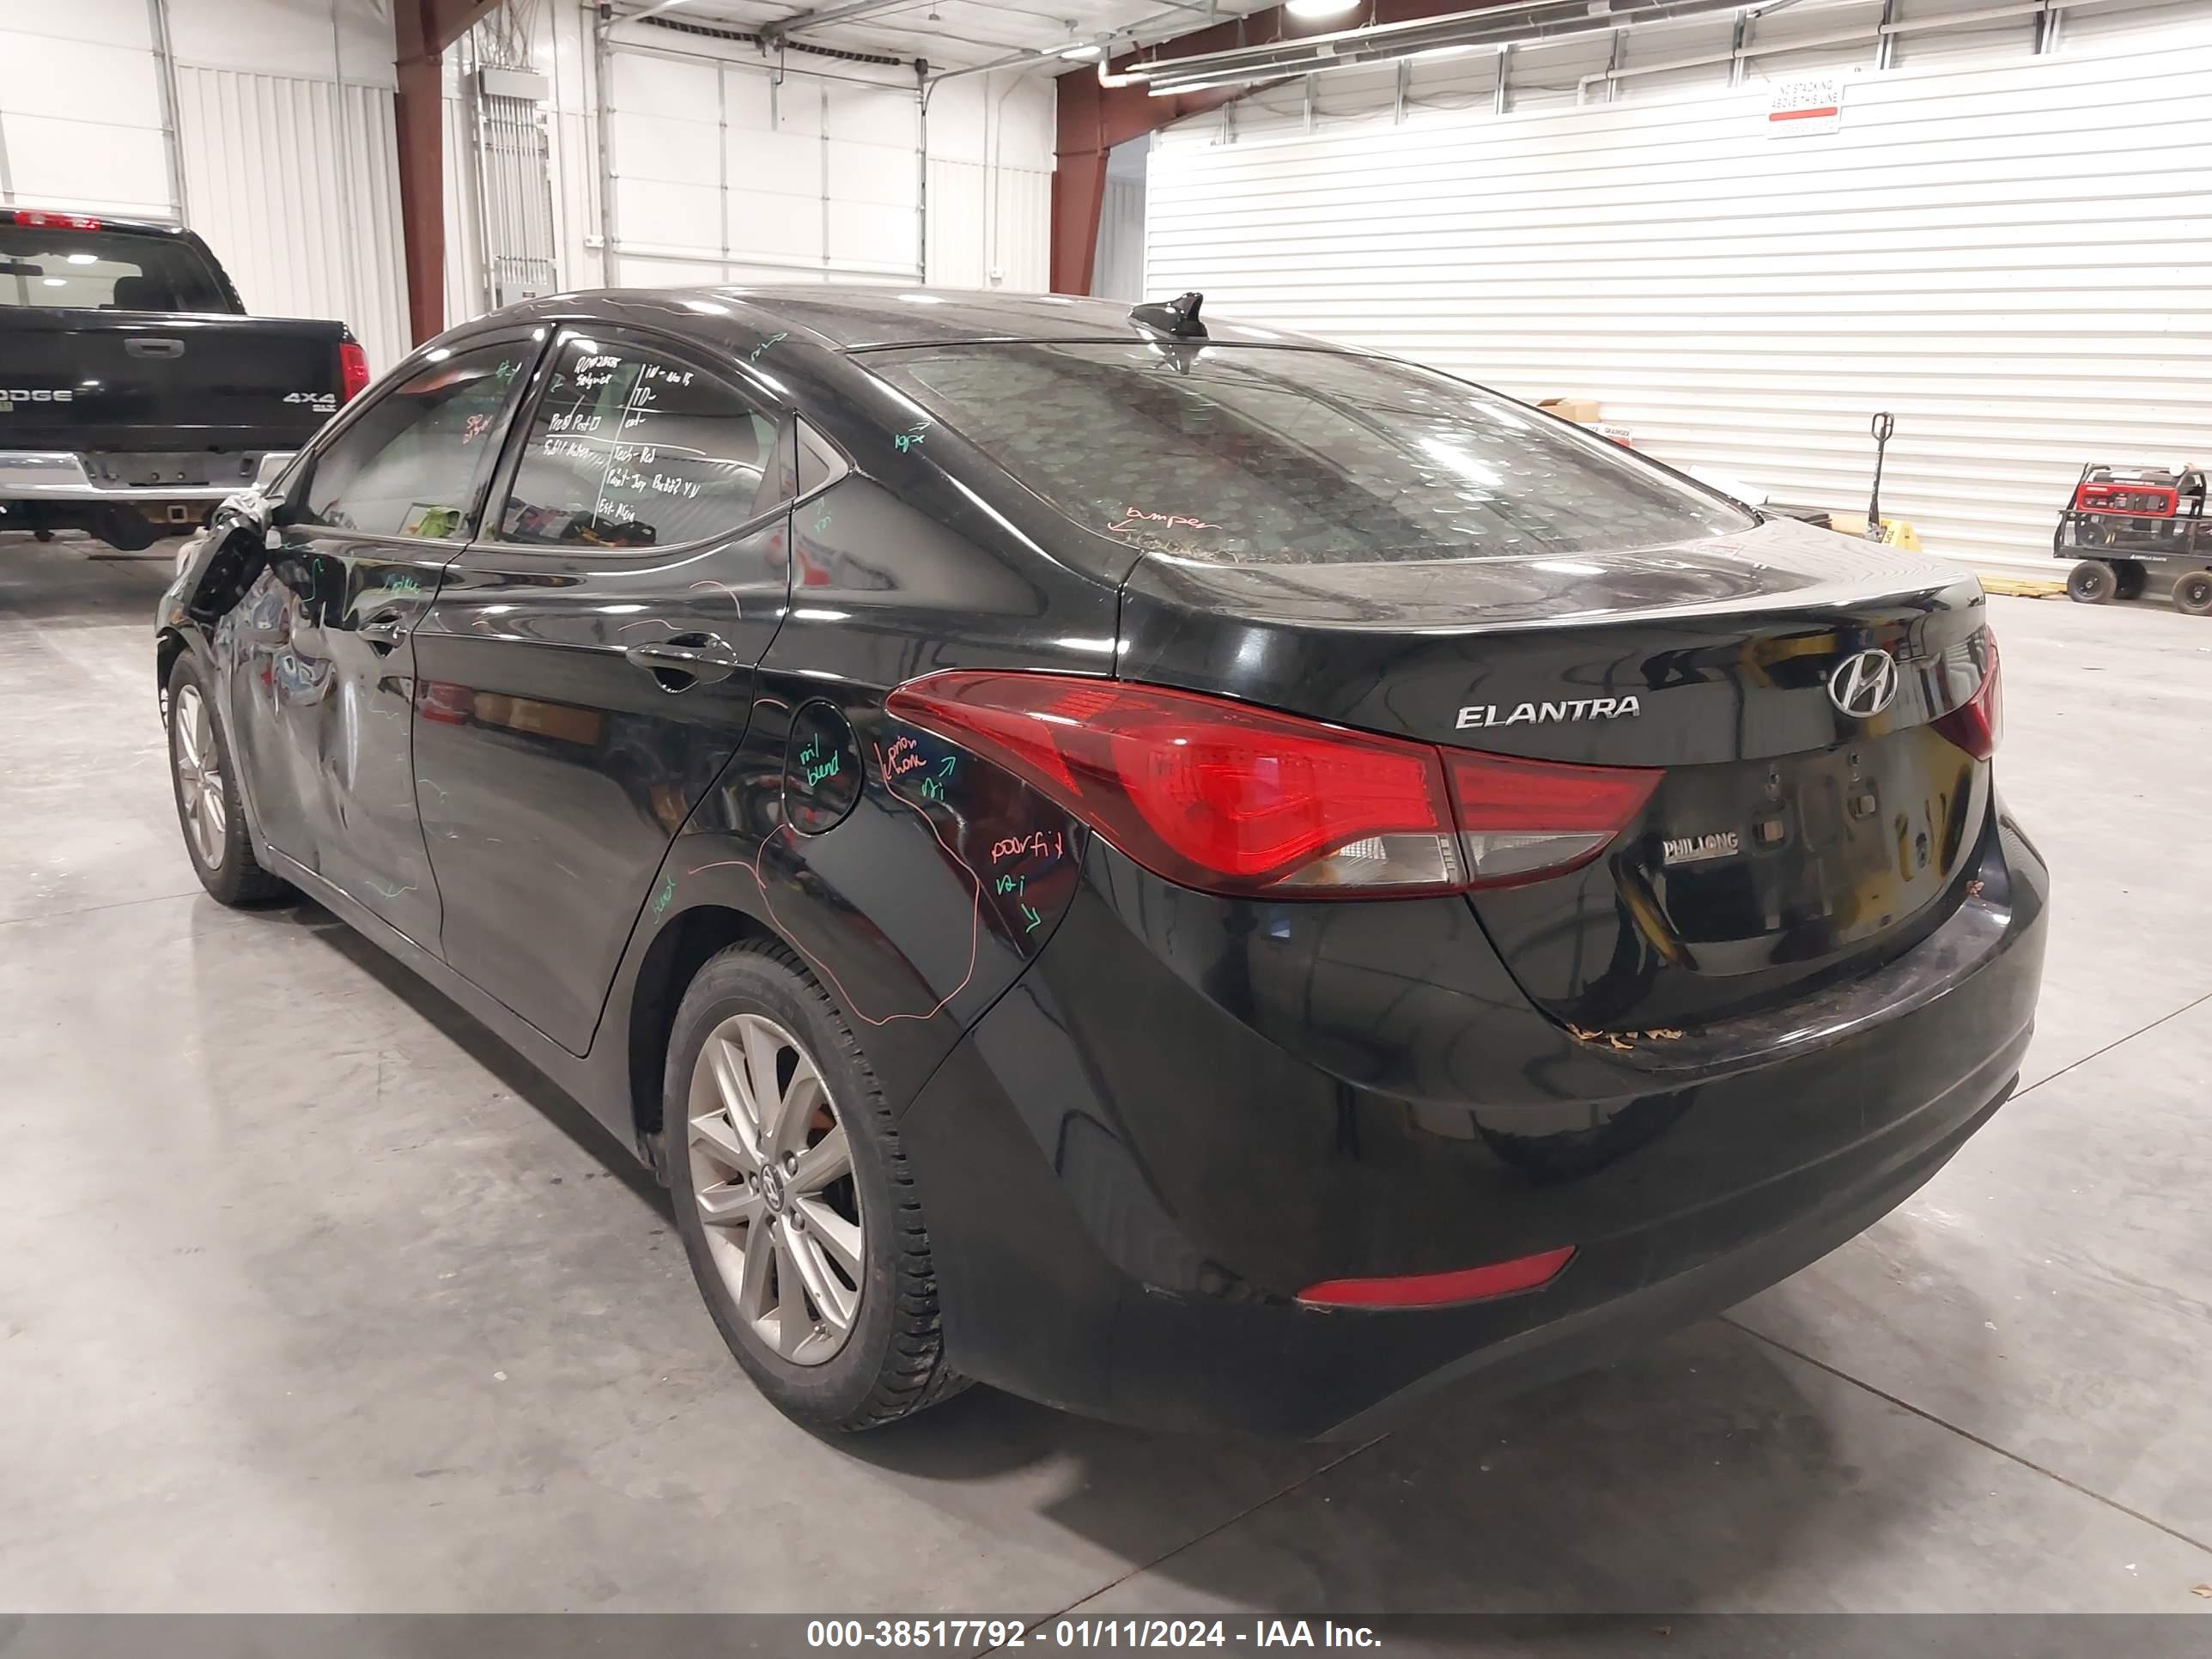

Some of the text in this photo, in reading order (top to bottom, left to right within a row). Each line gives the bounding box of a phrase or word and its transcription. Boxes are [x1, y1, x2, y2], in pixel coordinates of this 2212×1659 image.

[1127, 507, 1223, 528] bumper
[1455, 695, 1642, 730] ELANTRA
[806, 750, 841, 787] blend
